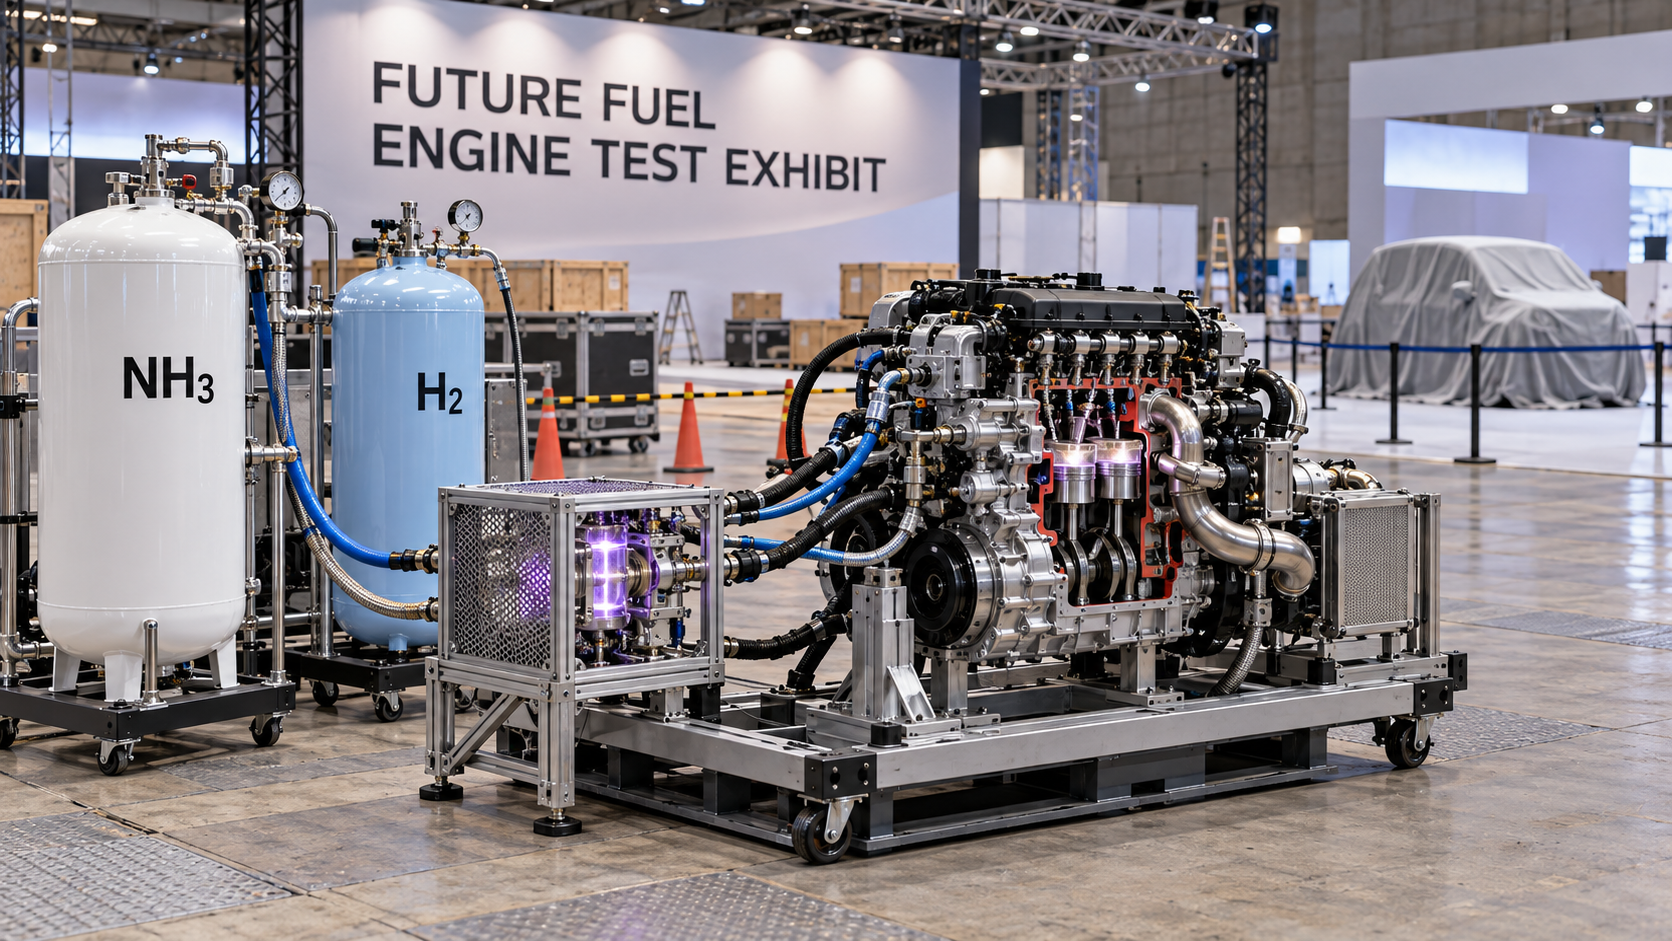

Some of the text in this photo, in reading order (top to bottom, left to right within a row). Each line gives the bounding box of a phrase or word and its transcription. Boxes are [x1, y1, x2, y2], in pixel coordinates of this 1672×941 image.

[373, 61, 716, 130] FUTURE FUEL
[373, 122, 887, 193] ENGINE TEST EXHIBIT
